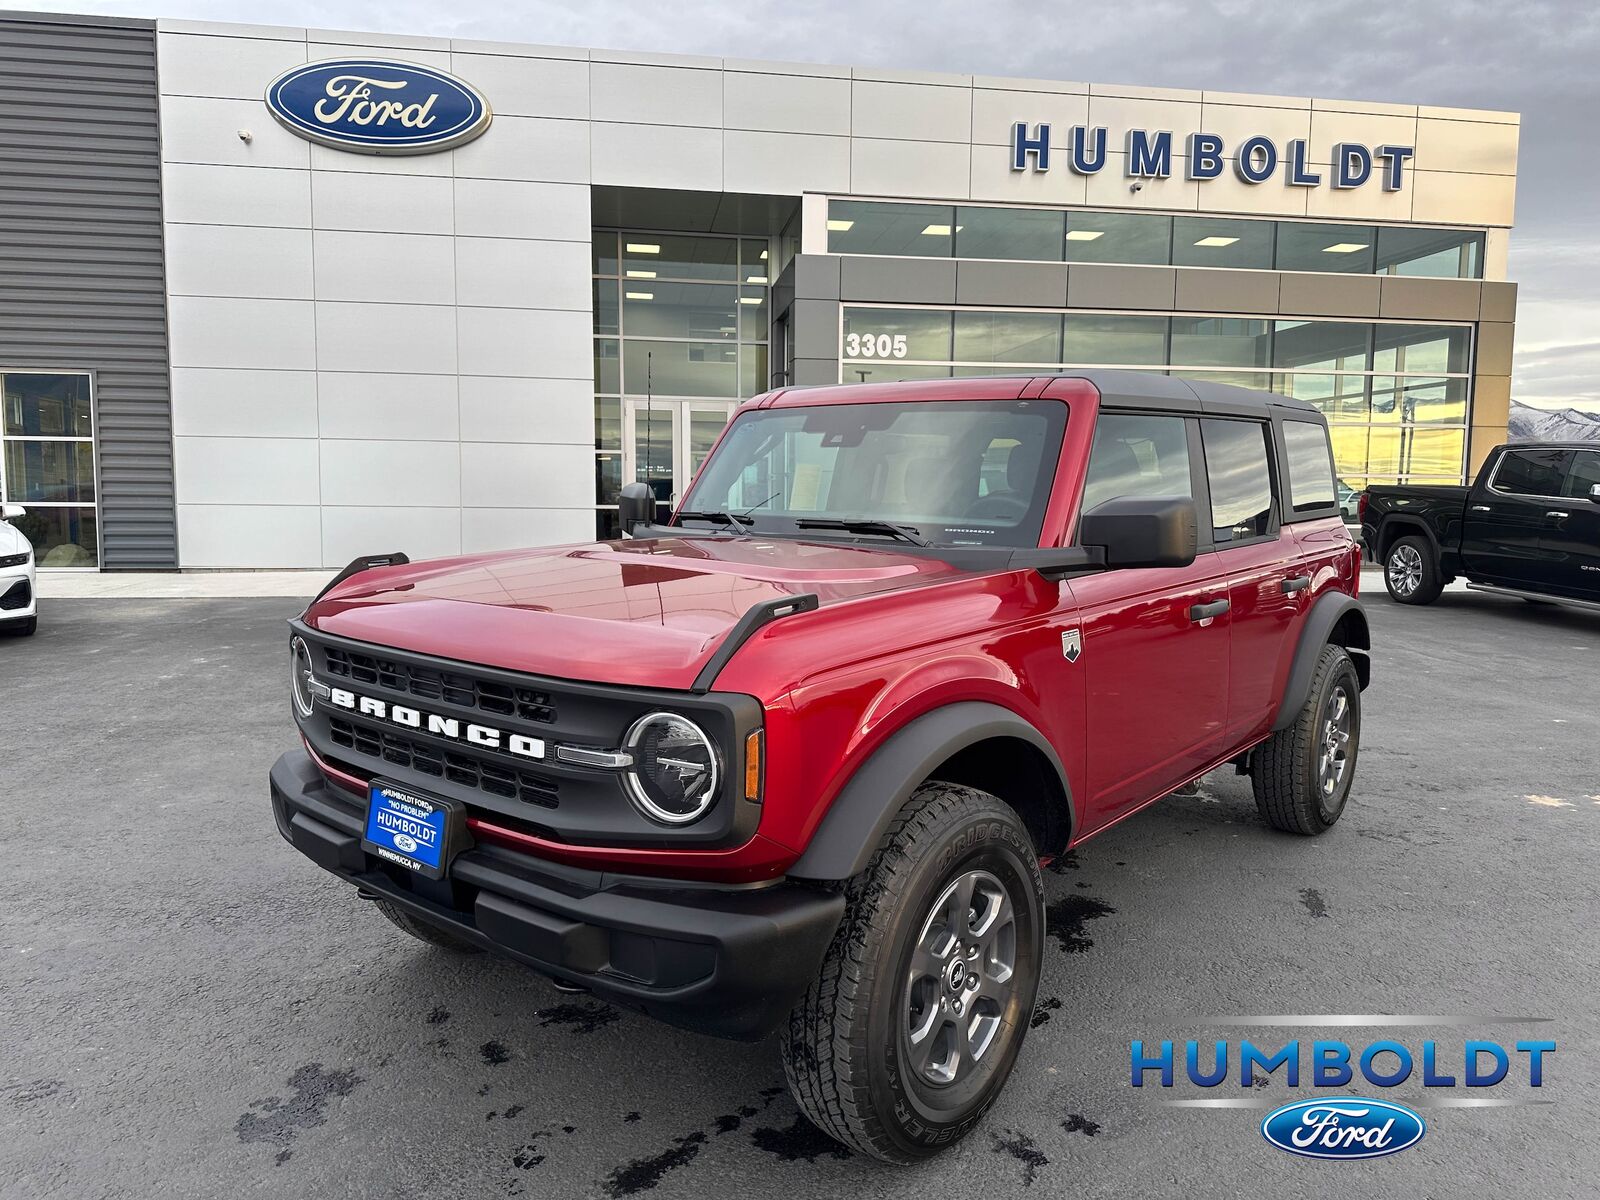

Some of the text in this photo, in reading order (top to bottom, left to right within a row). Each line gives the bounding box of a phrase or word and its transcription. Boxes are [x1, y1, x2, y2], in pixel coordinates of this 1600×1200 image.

[314, 75, 439, 129] Ford
[1011, 120, 1415, 192] HUMBOLDT
[846, 333, 907, 358] 3305
[331, 687, 545, 759] BRONCO
[385, 788, 430, 810] HUMBOLDT FORD
[377, 811, 437, 843] HUMBOLDT
[398, 836, 413, 849] Ford
